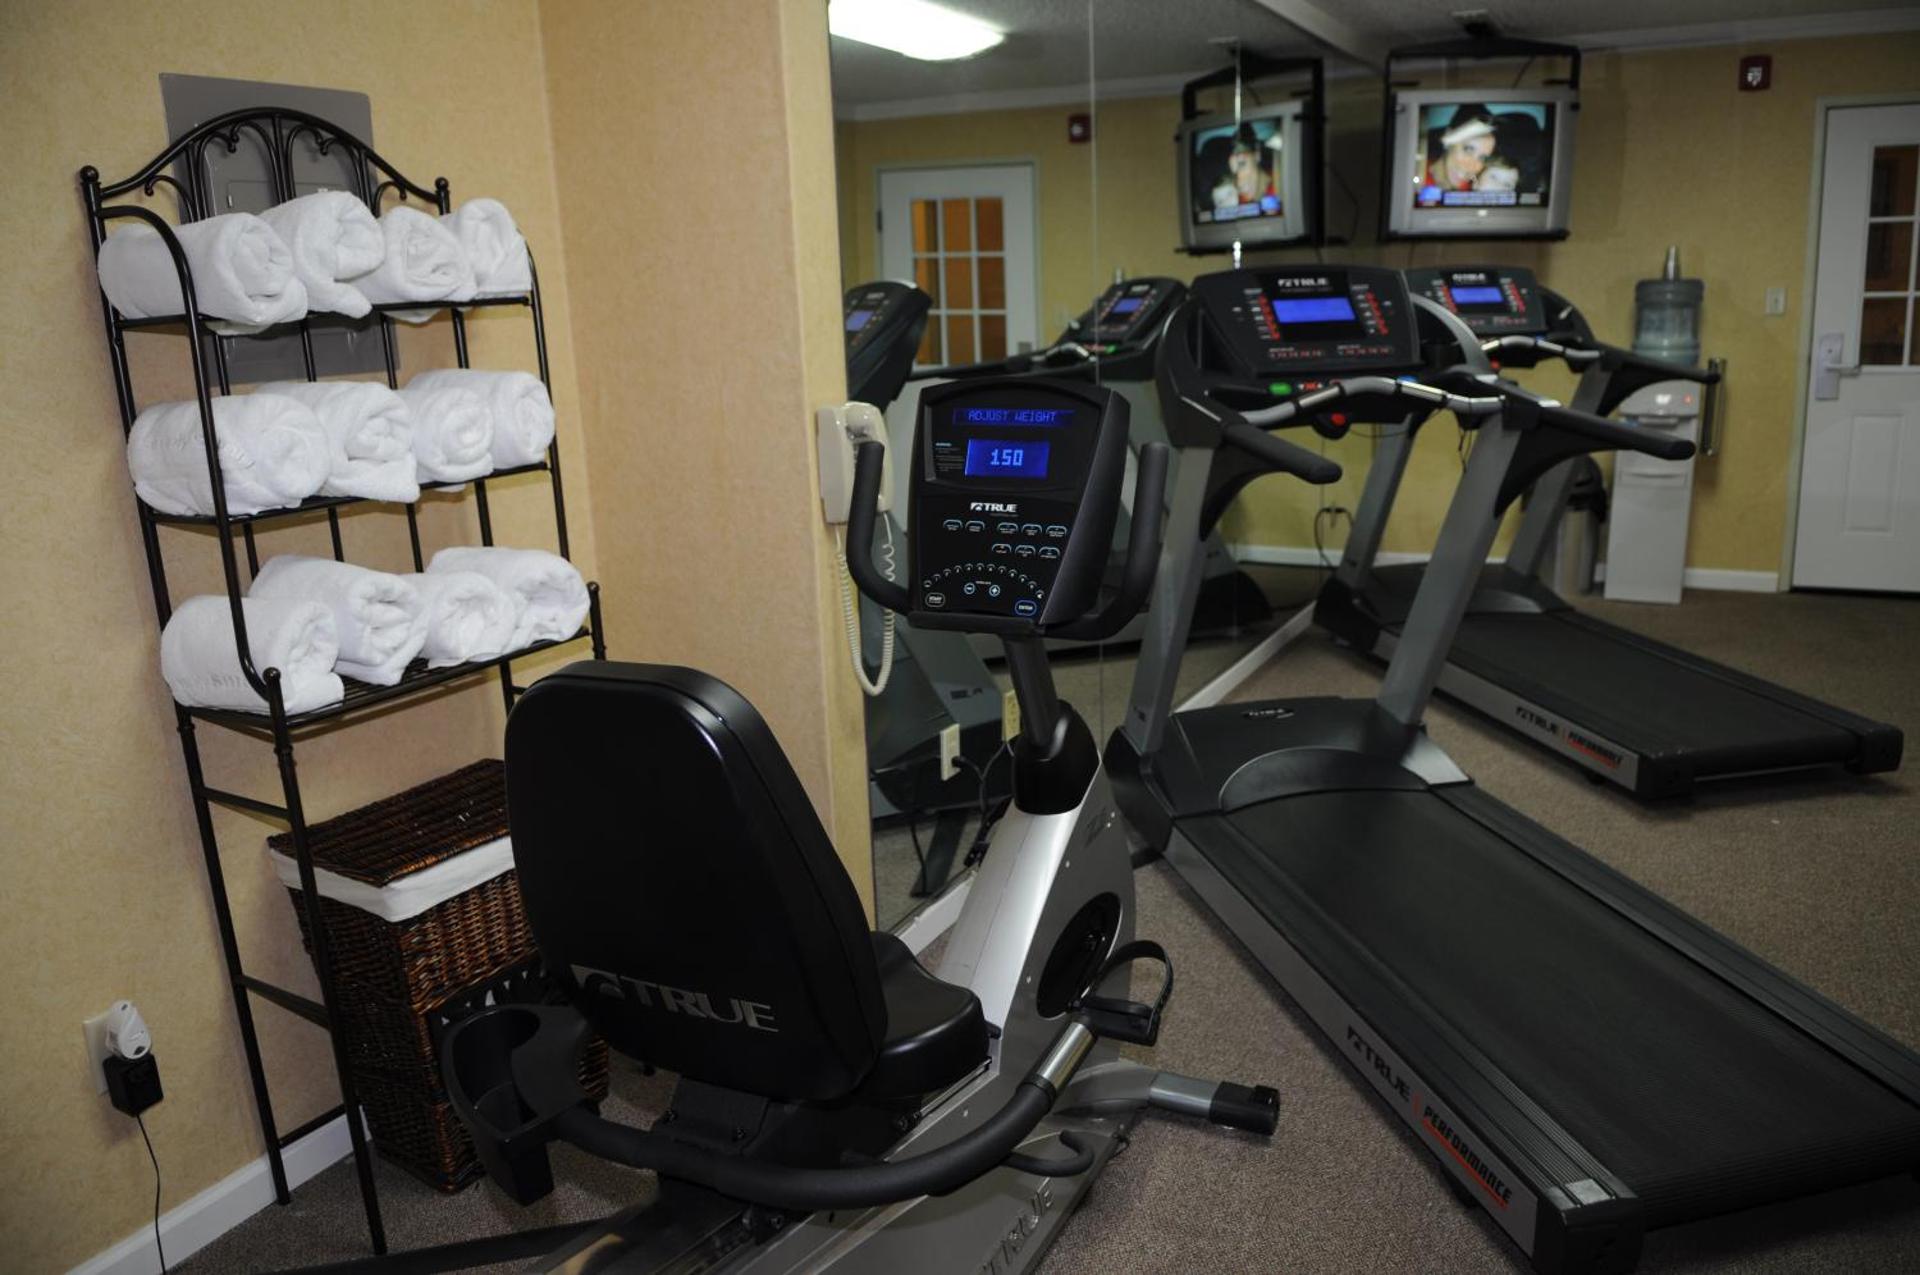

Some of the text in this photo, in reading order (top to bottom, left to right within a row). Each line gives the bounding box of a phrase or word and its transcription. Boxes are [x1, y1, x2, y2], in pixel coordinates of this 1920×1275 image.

[1293, 278, 1328, 287] TRUE
[968, 410, 1056, 422] ADJUST WEIGHT
[990, 449, 1024, 466] 150
[984, 503, 1017, 512] TRUE
[1528, 712, 1559, 735] TRUE
[619, 975, 779, 1032] TRUE
[1363, 1049, 1513, 1202] TRUE PERFORMANCE
